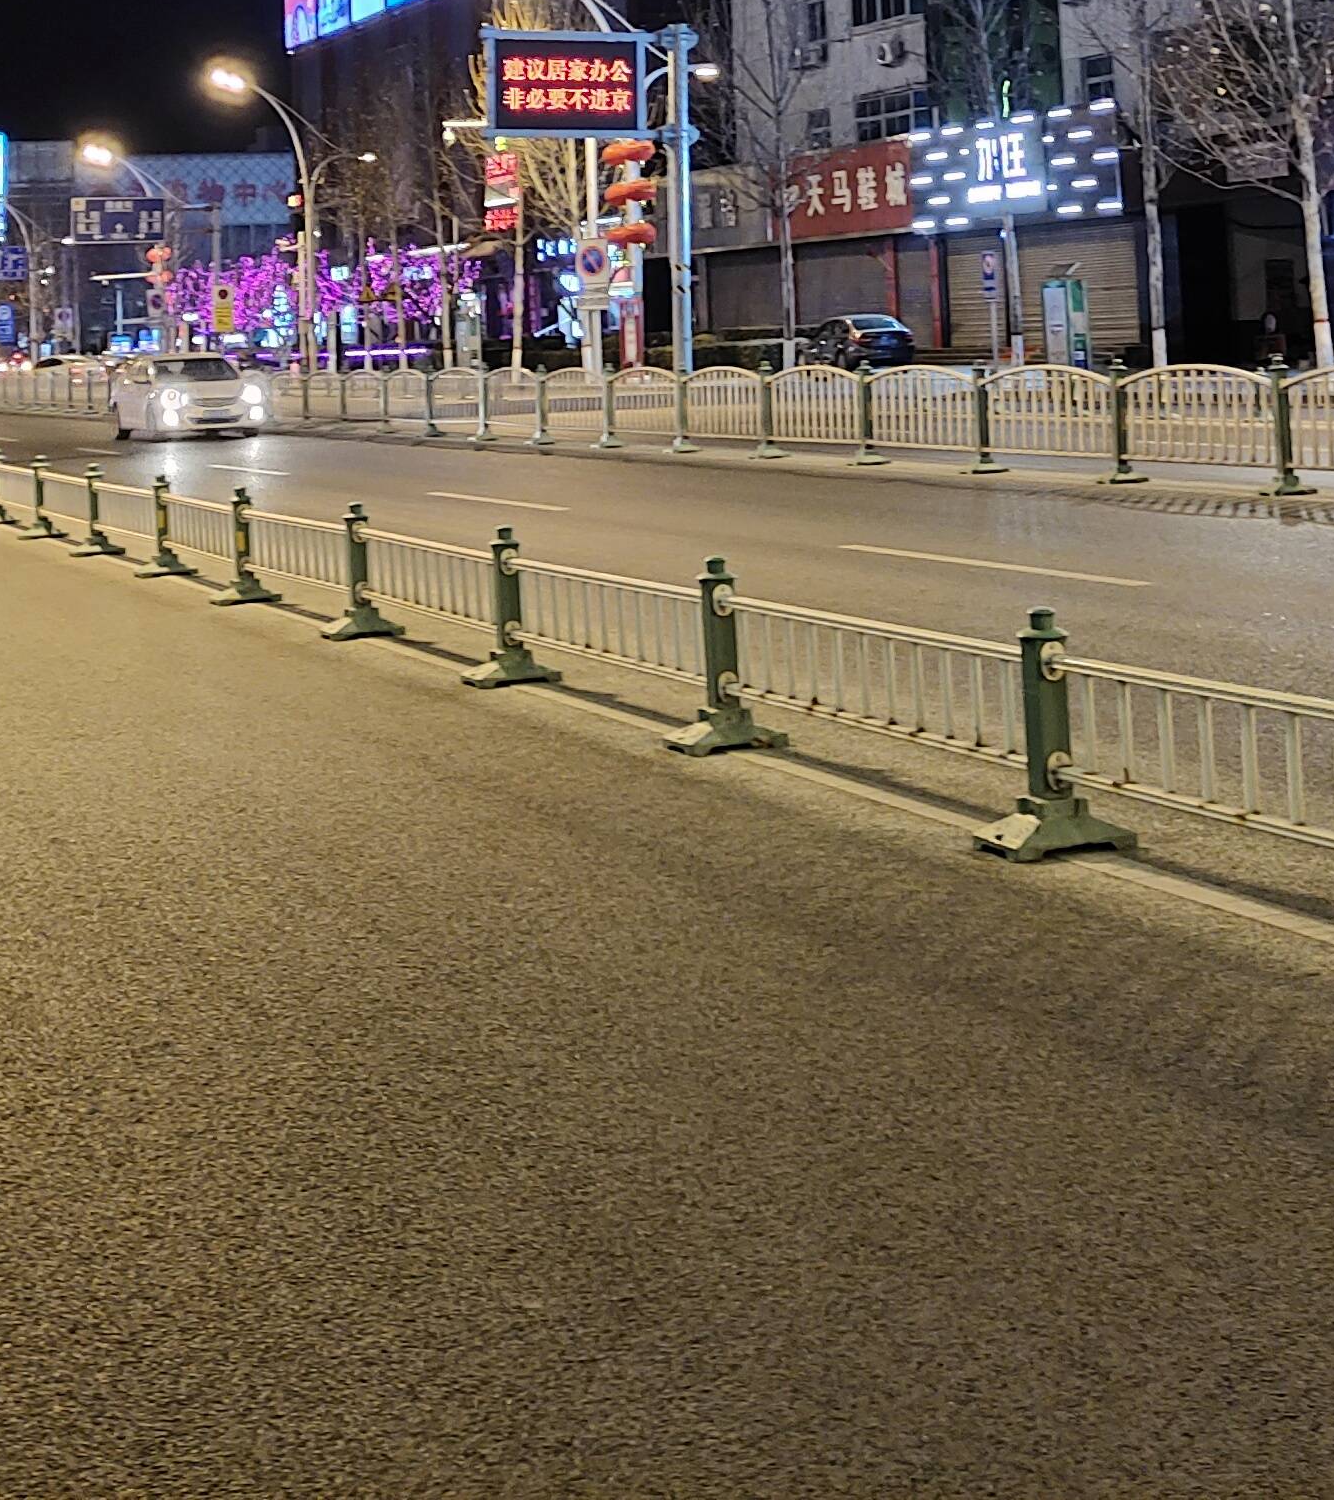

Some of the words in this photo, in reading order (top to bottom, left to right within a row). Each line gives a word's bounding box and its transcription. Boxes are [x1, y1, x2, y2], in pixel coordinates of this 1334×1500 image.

[502, 57, 632, 82] 建议居家办公
[502, 88, 632, 111] 非必要不进京
